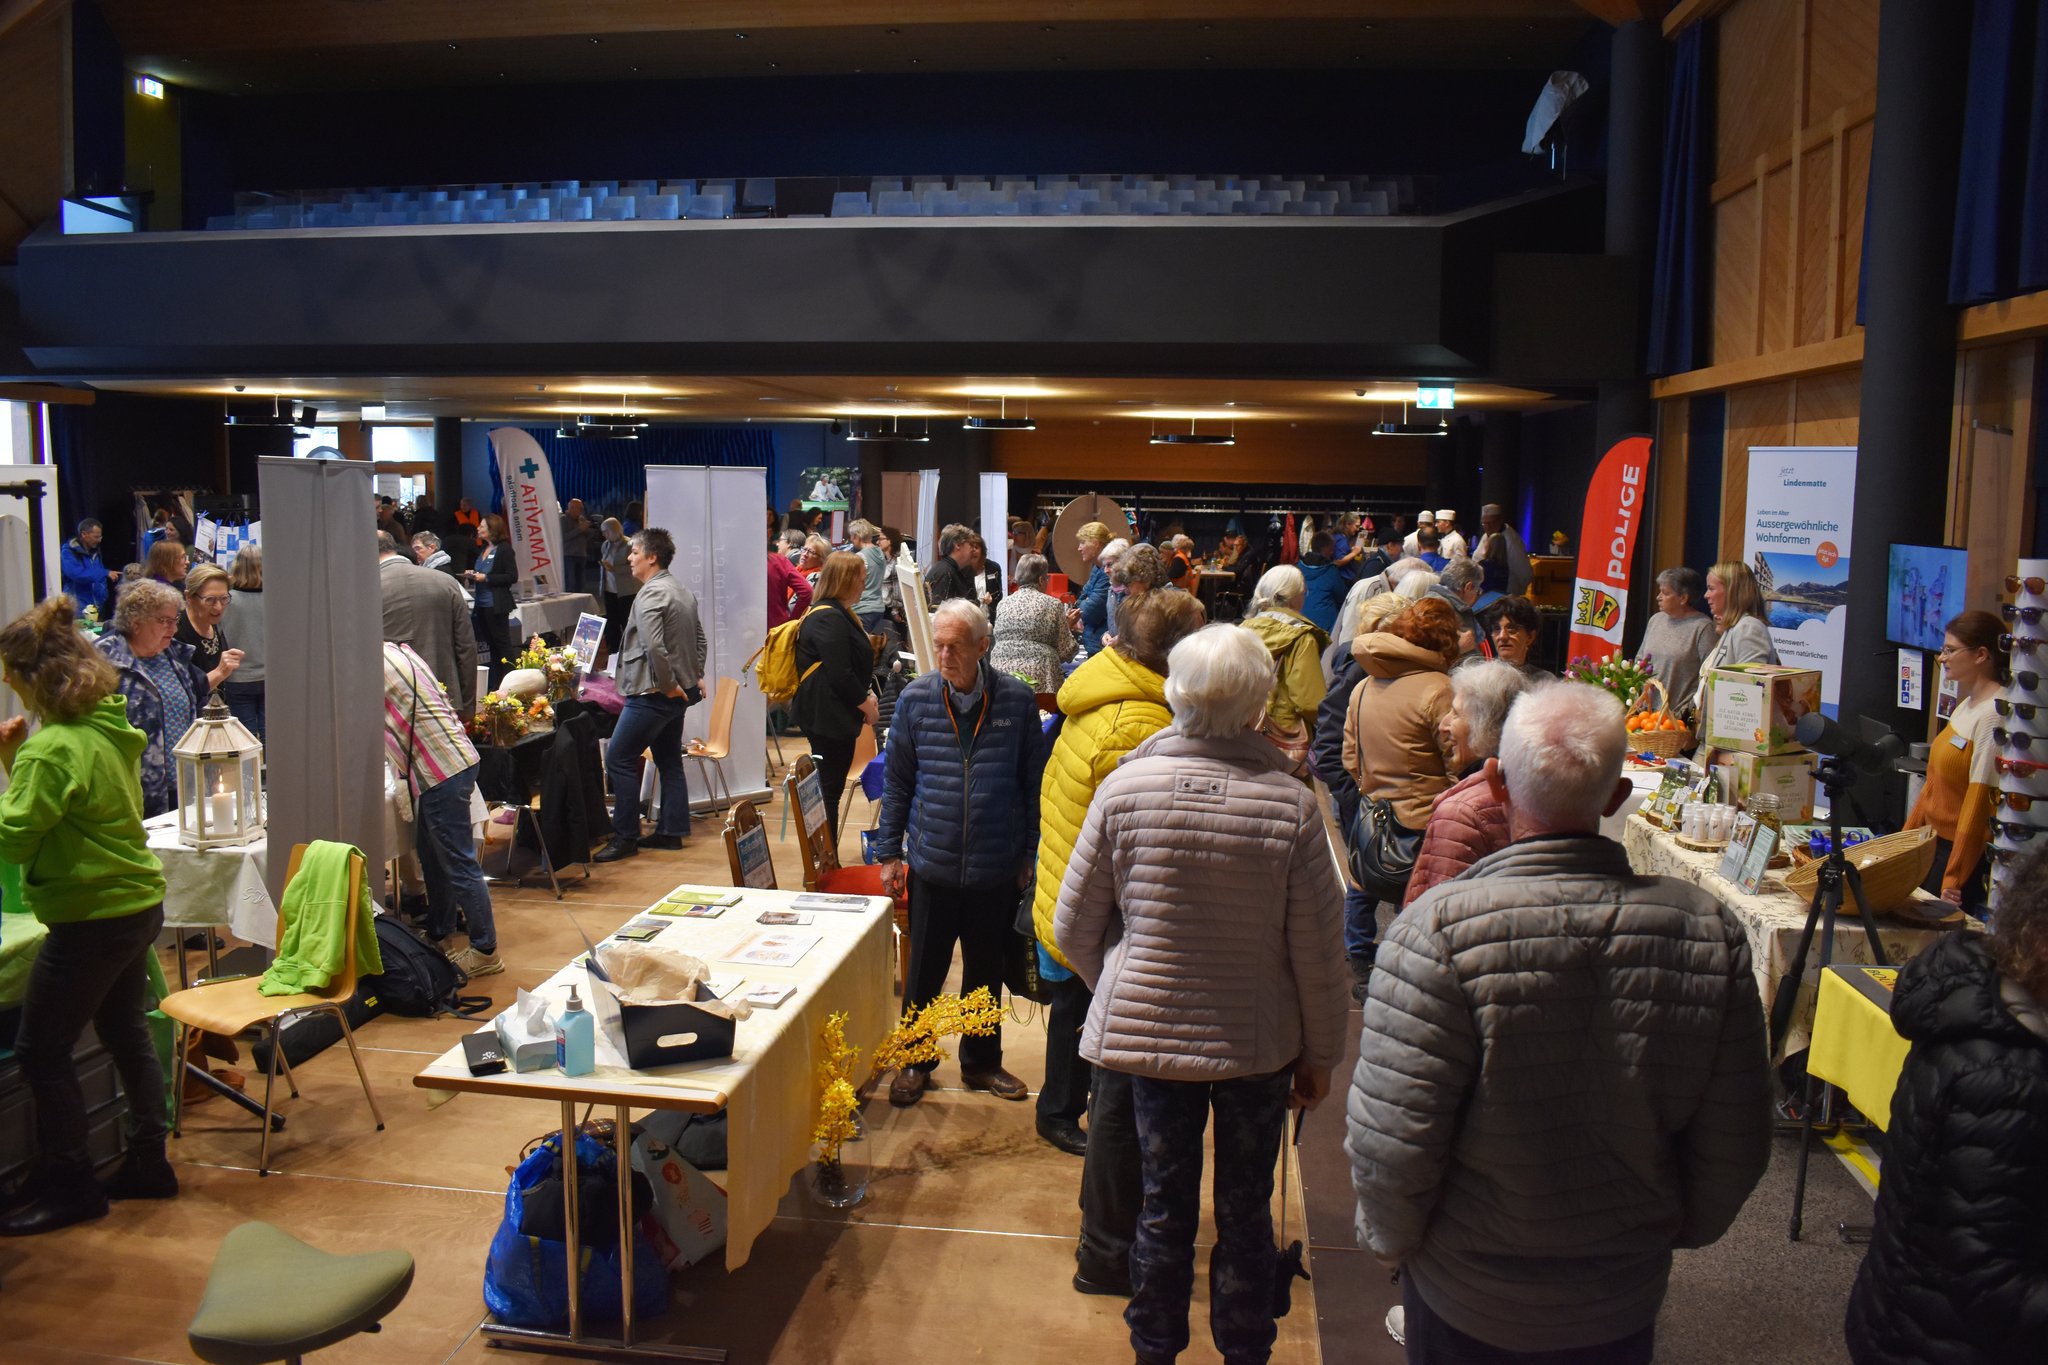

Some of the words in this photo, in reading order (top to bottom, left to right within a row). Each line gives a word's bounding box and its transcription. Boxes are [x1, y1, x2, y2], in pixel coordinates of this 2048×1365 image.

[1783, 479, 1827, 487] Lindenmatte
[1607, 463, 1640, 580] POLICE
[1756, 519, 1839, 532] Aussergewöhnliche
[1756, 532, 1810, 545] Wohnformen
